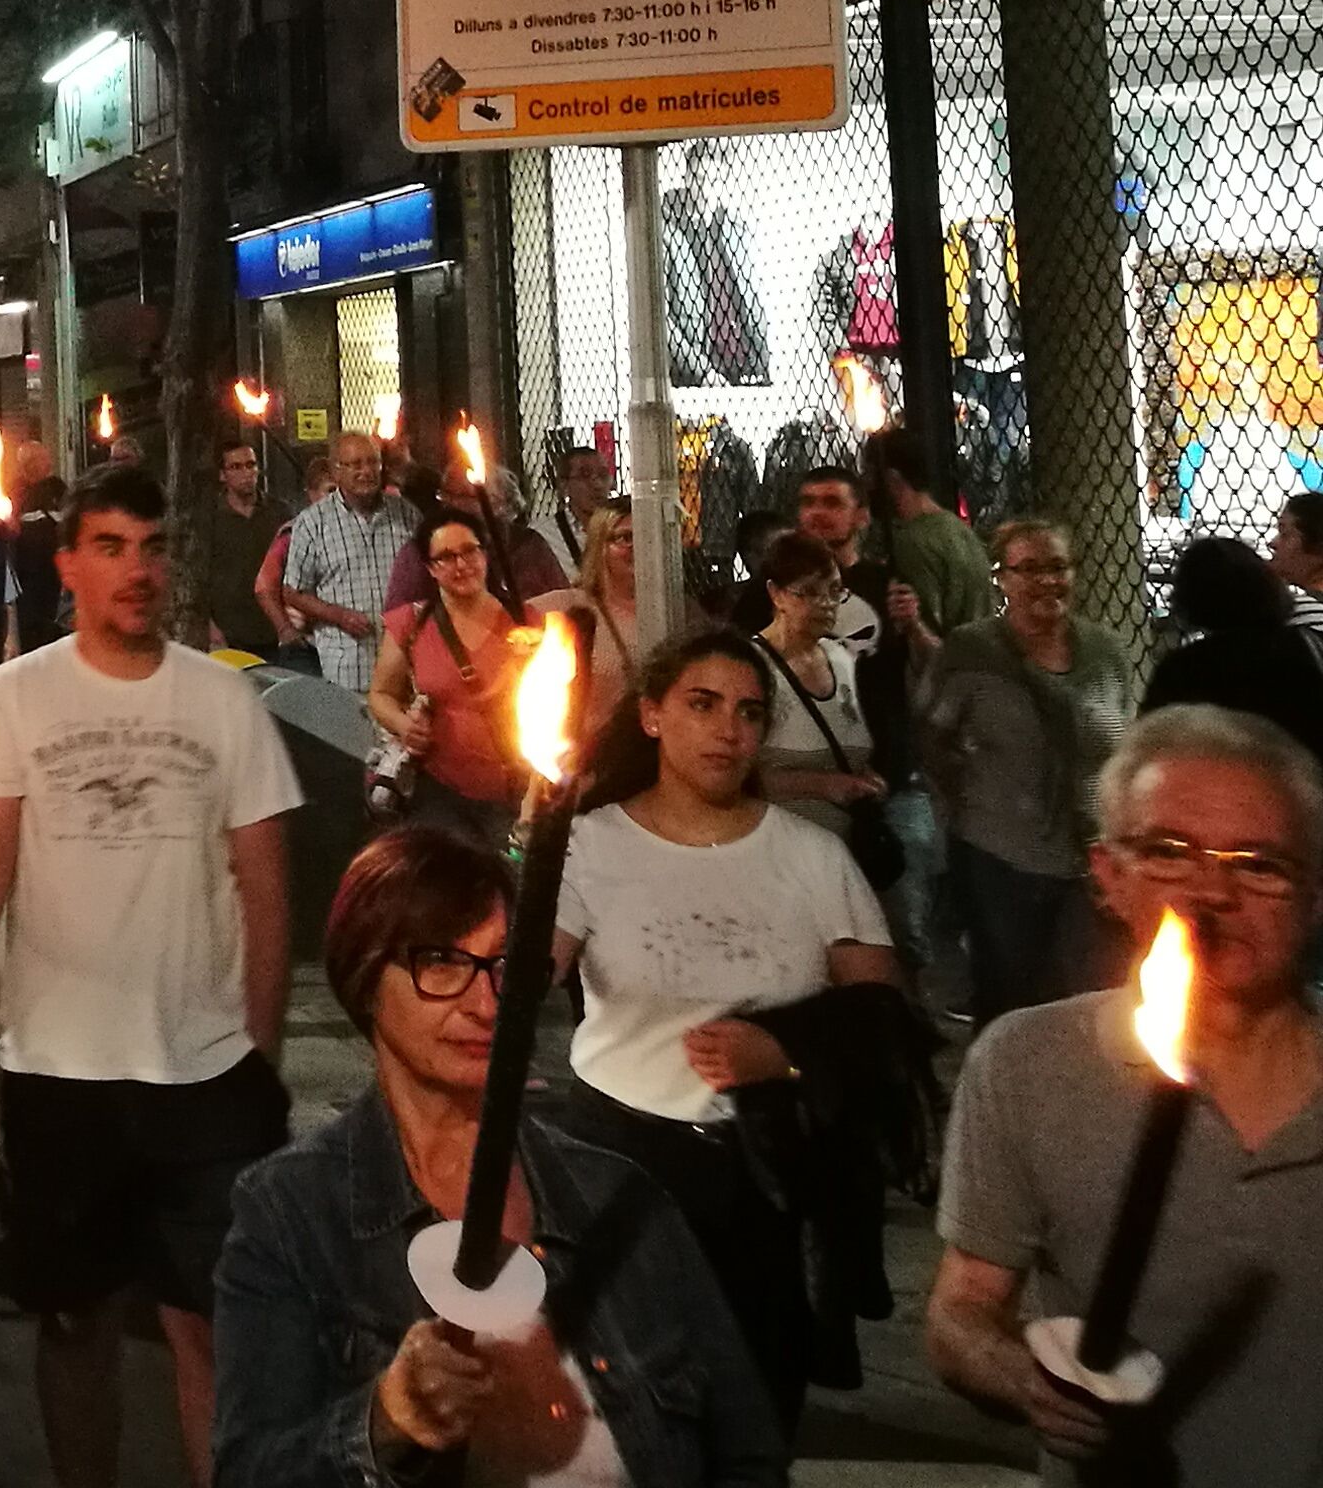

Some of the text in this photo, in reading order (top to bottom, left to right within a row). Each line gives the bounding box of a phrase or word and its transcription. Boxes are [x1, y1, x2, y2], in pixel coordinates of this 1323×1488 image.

[454, 17, 503, 35] Dilluns
[508, 20, 519, 31] a
[523, 10, 597, 30] divendres
[690, 1, 701, 16] h
[531, 36, 609, 55] Dissabtes
[708, 27, 718, 42] h
[528, 97, 610, 121] Control
[620, 93, 648, 115] de
